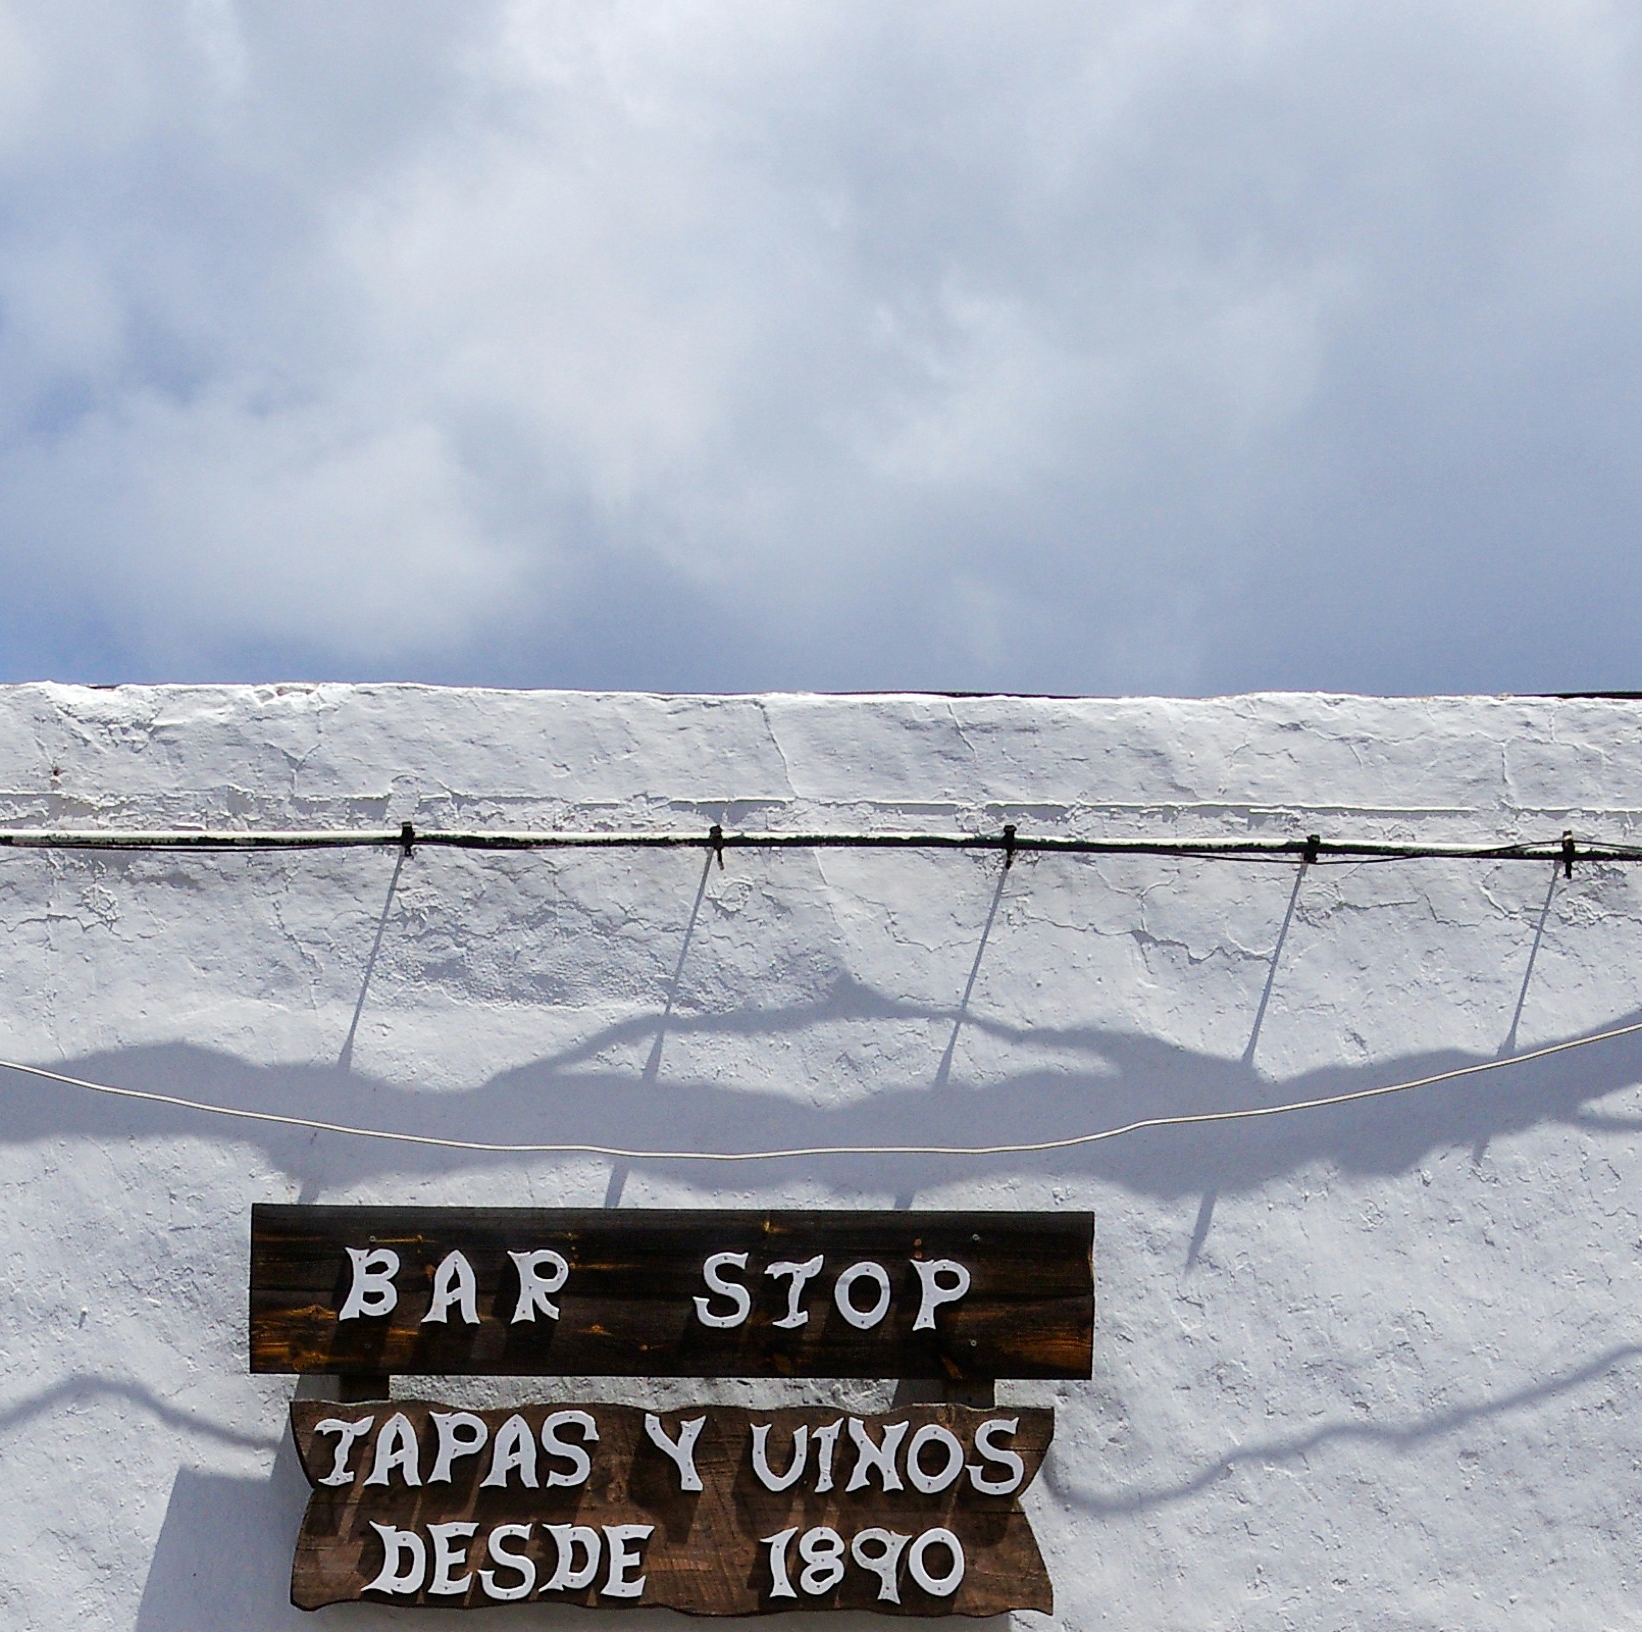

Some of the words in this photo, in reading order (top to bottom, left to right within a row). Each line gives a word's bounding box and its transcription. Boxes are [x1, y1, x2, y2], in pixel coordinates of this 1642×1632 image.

[339, 1247, 569, 1323] BAR
[693, 1252, 971, 1330] STOP
[314, 1409, 600, 1487] TAPAS
[644, 1412, 707, 1490] Y
[361, 1520, 656, 1599] DESDE
[760, 1525, 965, 1603] 1890
